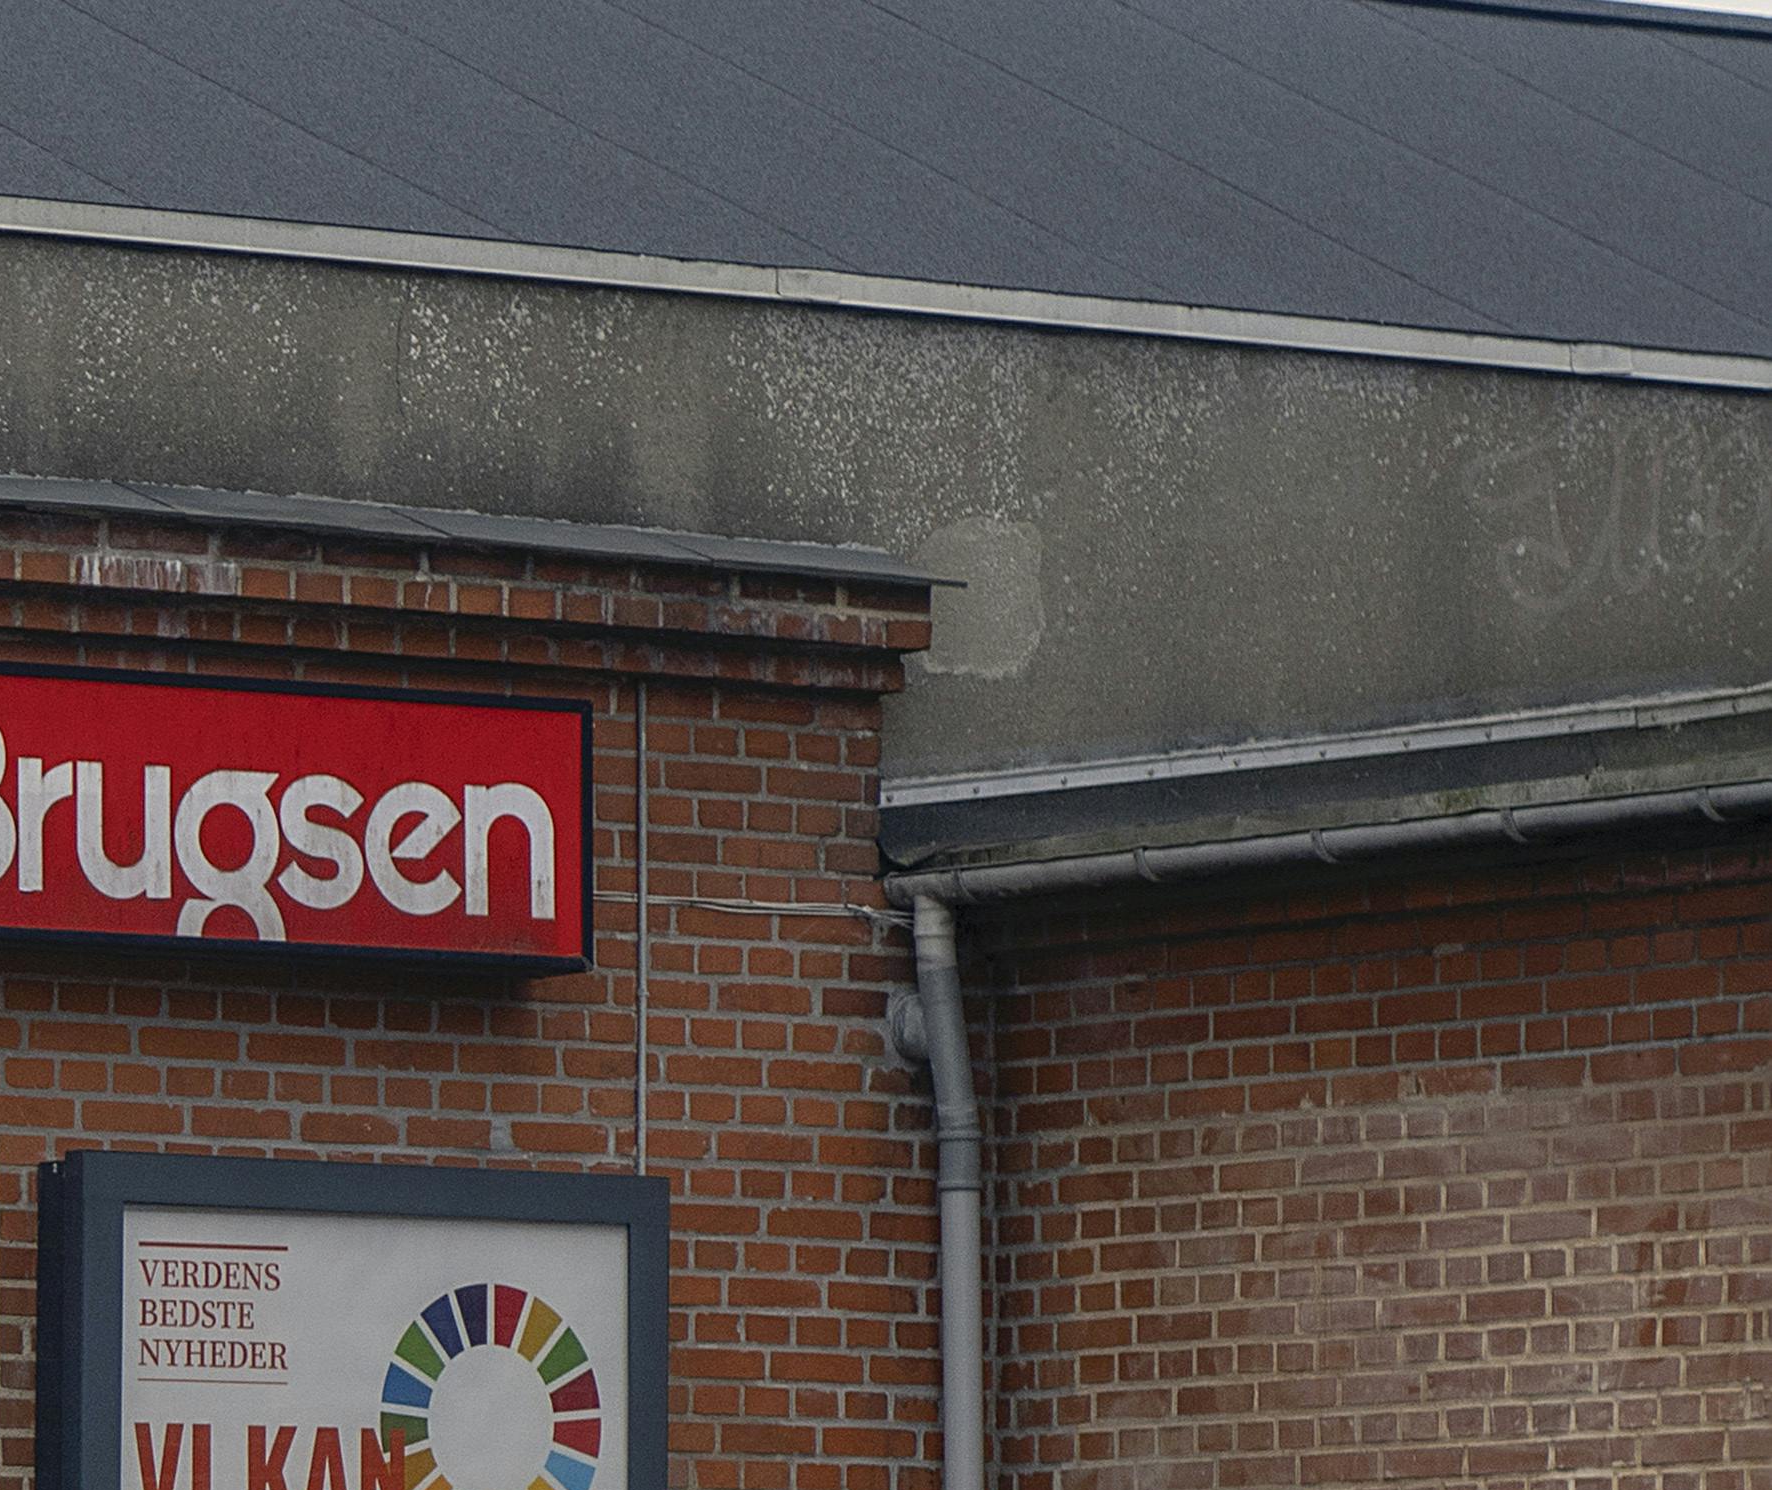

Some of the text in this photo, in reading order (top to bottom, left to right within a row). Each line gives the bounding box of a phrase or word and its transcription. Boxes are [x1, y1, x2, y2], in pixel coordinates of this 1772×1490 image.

[139, 1257, 282, 1292] VERDENS
[138, 1298, 256, 1332] BEDSTE
[138, 1337, 289, 1371] NYHEDER
